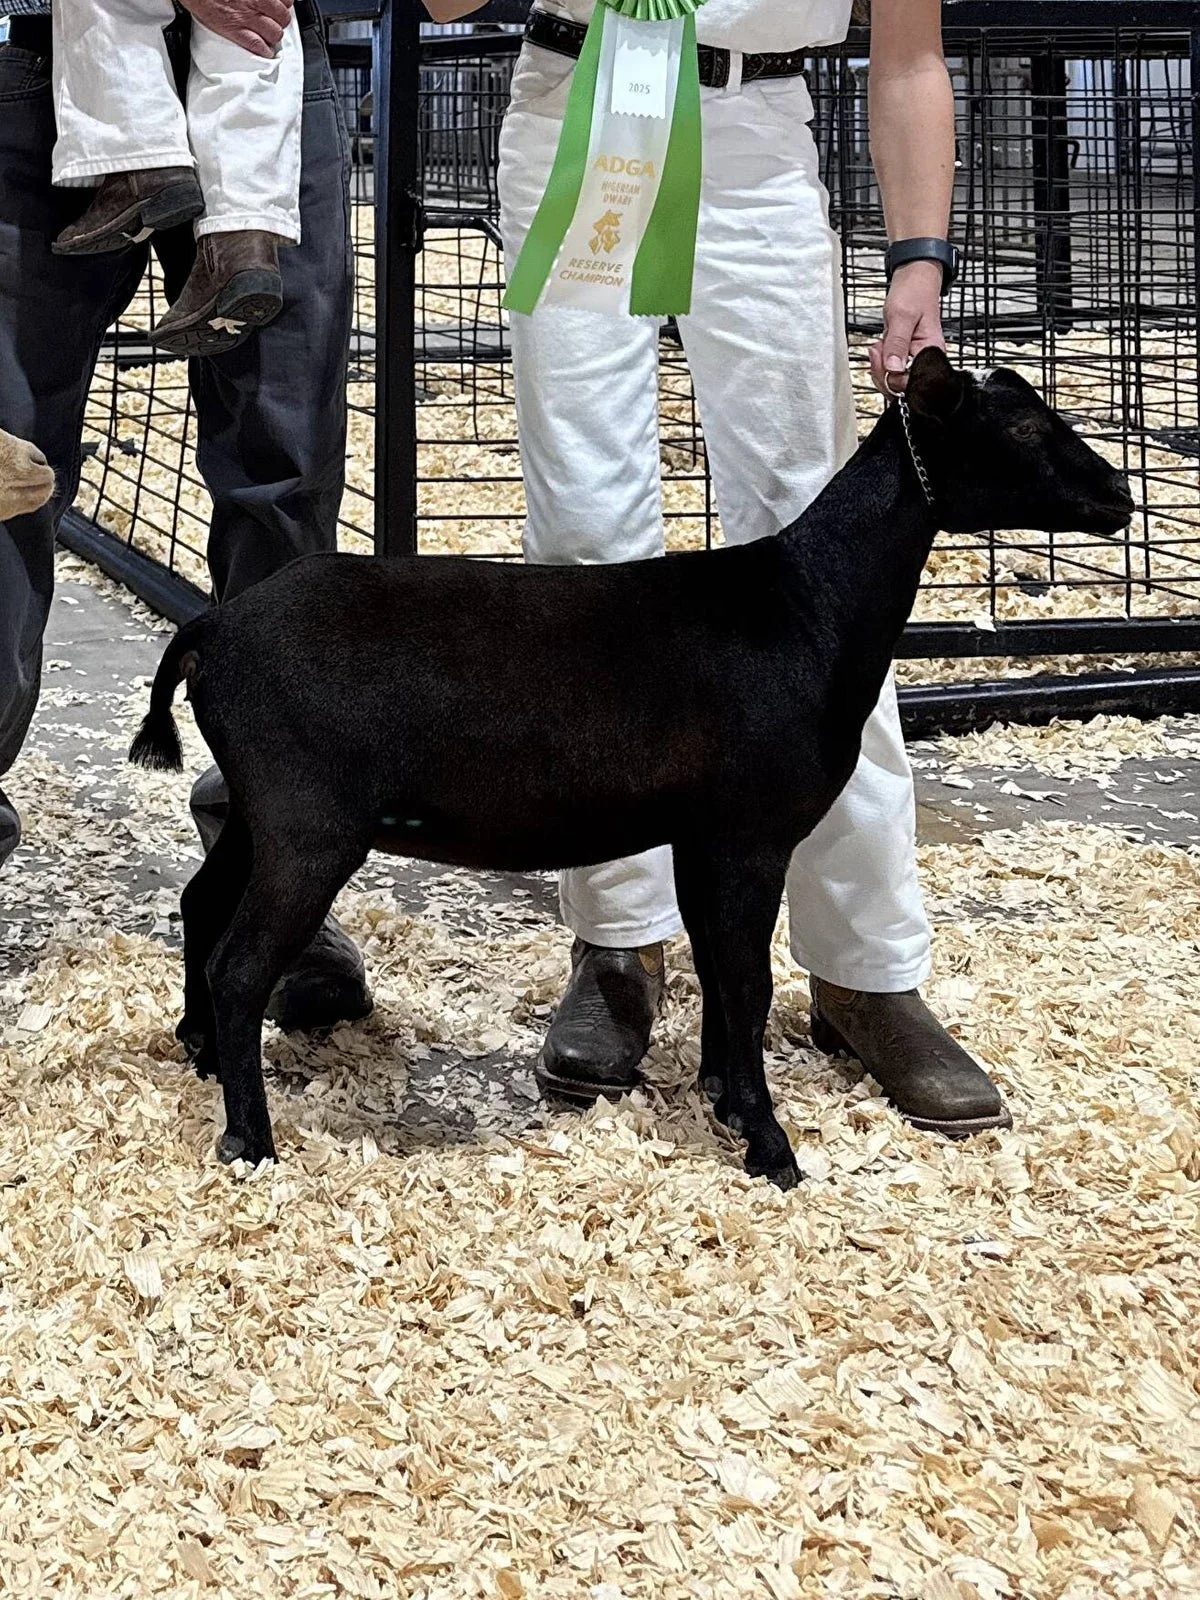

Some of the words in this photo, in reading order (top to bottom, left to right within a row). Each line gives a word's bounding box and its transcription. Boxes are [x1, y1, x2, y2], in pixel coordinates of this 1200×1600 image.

[628, 83, 651, 95] 2025
[593, 154, 656, 180] ADGA
[601, 180, 641, 195] NIGERIAN
[603, 192, 633, 205] DWARF
[568, 257, 624, 273] RESERVE
[559, 270, 625, 287] CHAMPION
